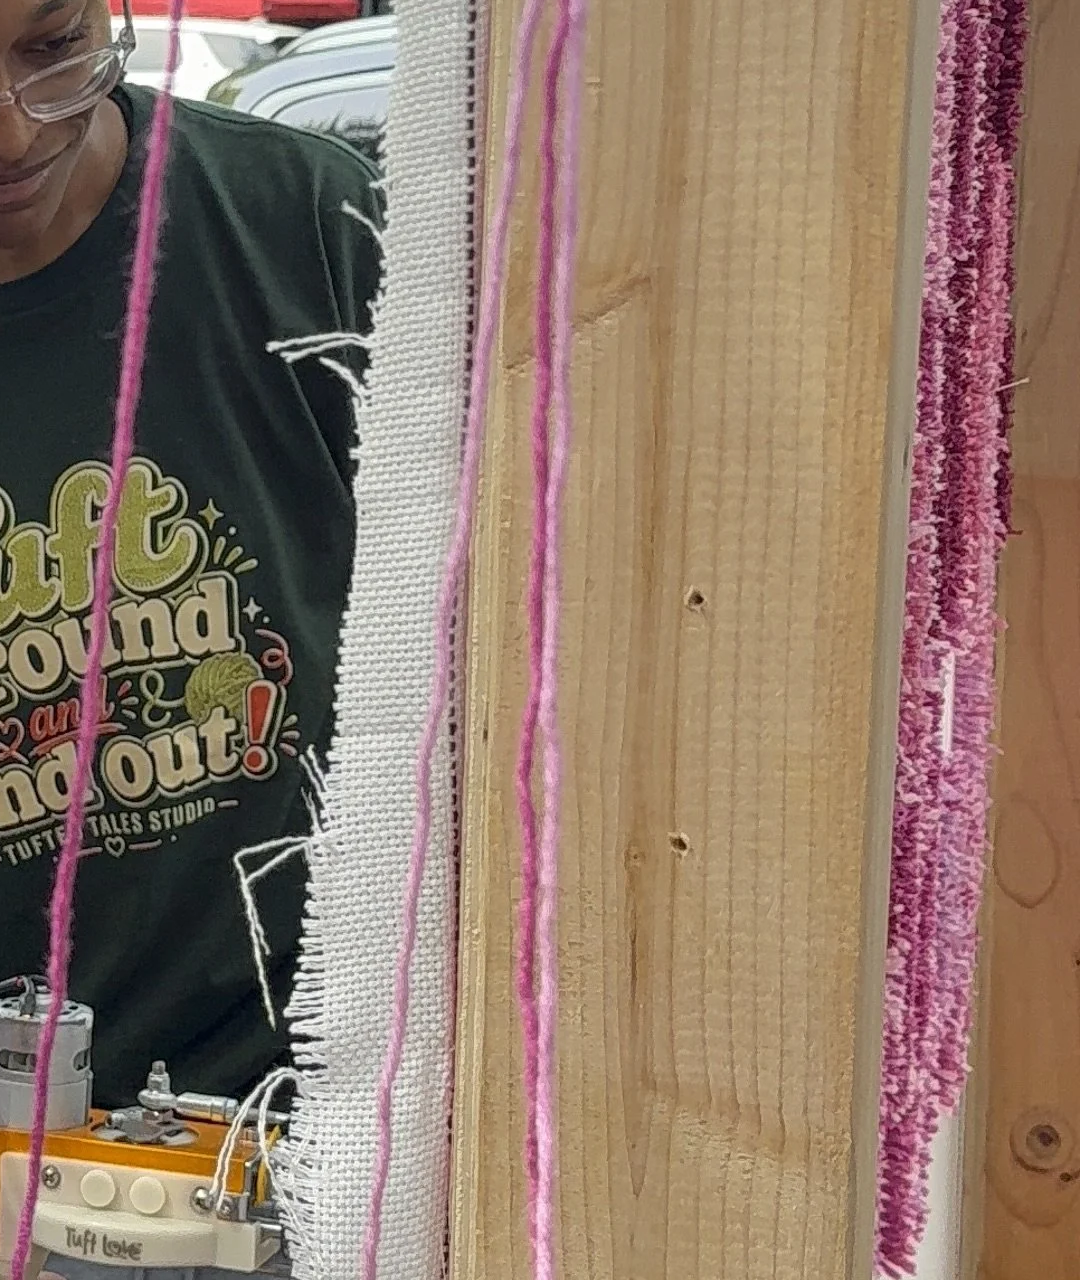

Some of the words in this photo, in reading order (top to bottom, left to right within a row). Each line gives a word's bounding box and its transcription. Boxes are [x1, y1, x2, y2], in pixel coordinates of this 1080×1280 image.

[105, 683, 280, 801] out!
[3, 825, 84, 866] TUFTE
[87, 812, 144, 838] TALES
[149, 797, 216, 833] STUDIO
